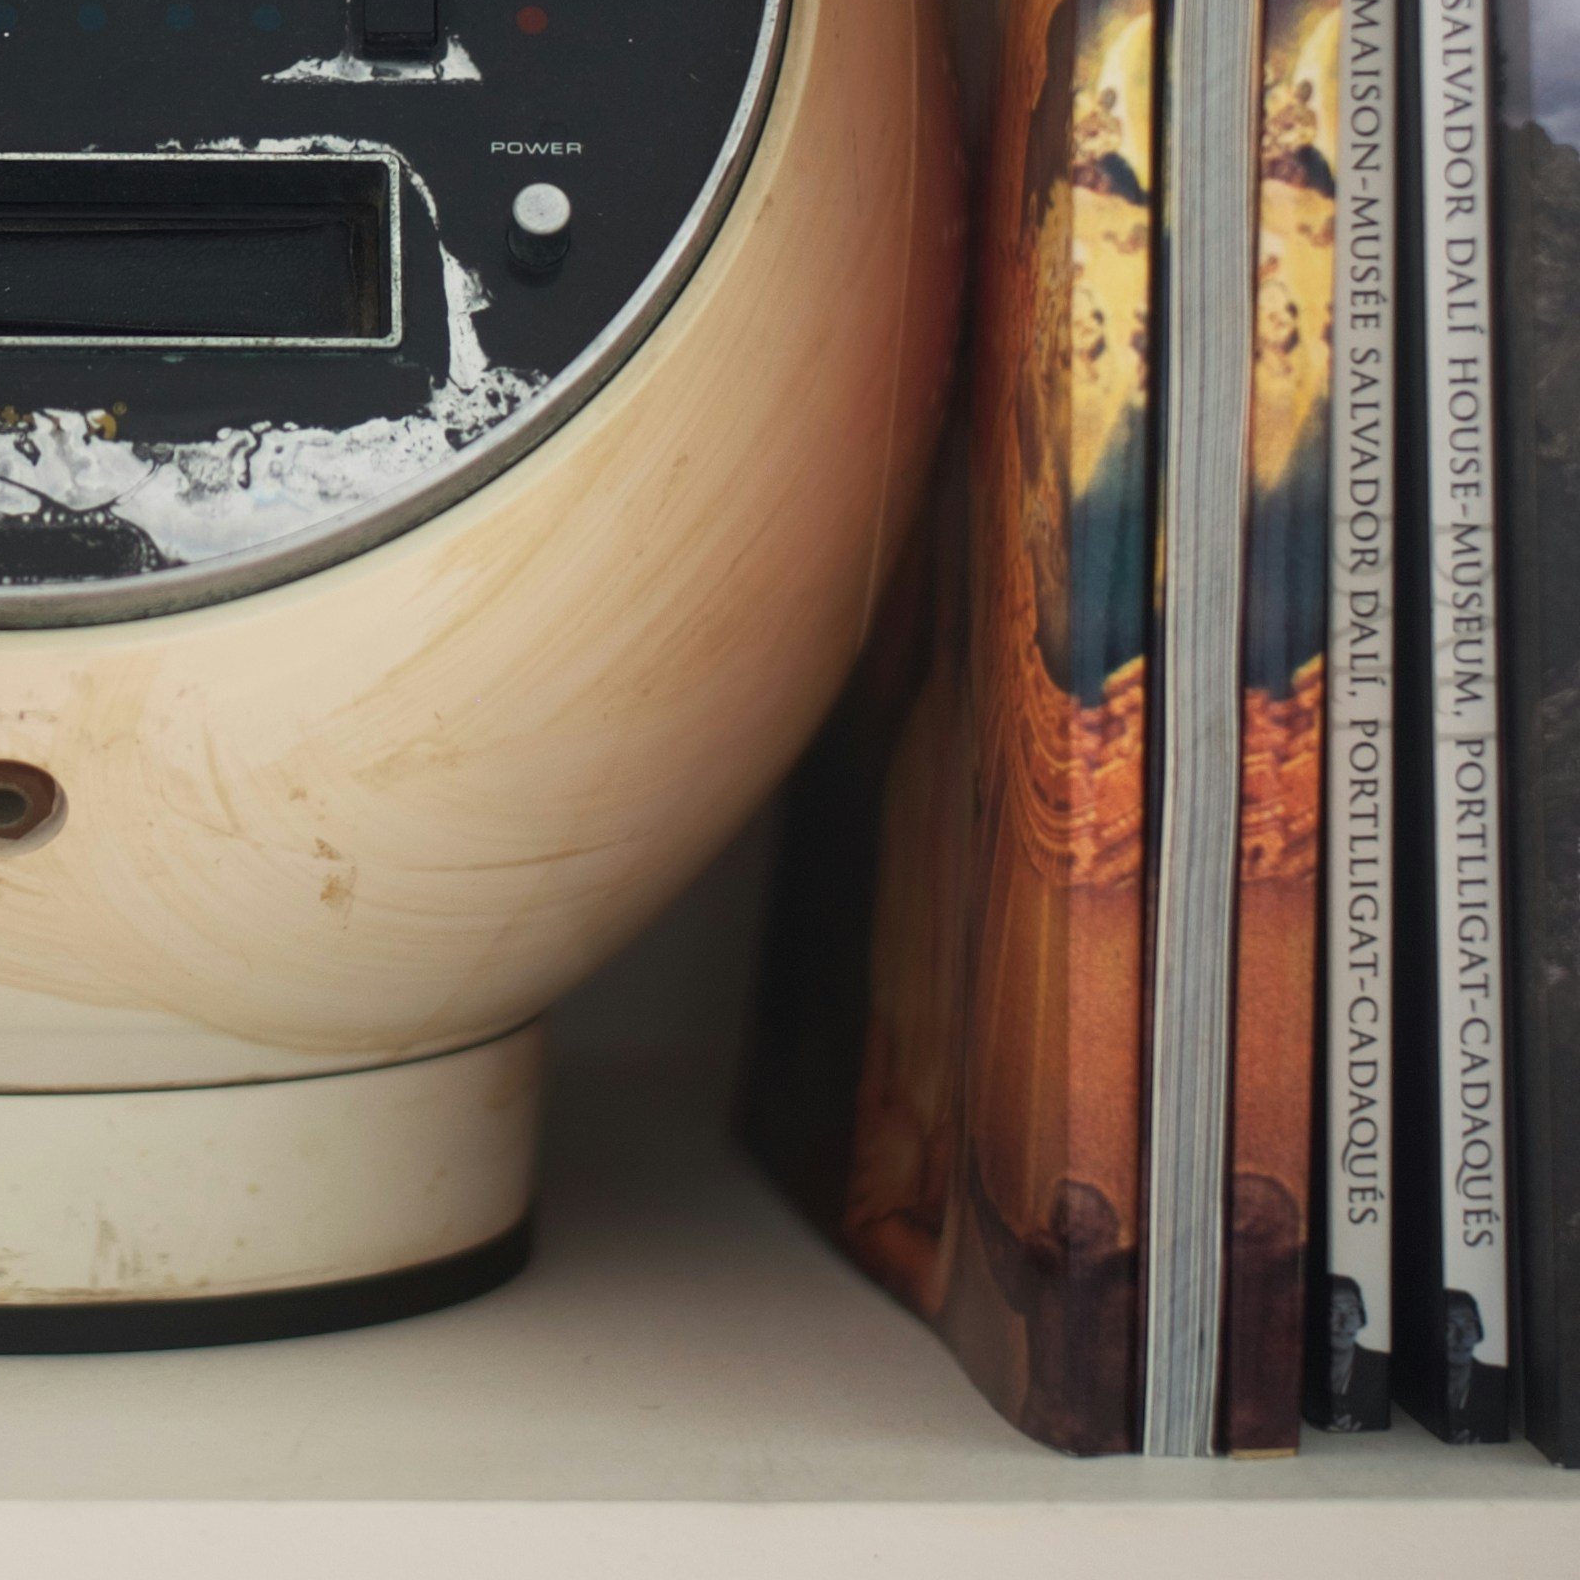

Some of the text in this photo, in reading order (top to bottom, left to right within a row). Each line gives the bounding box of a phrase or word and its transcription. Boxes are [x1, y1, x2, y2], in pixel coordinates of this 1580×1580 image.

[490, 141, 583, 155] POWER
[1444, 234, 1486, 335] DALÍ
[1349, 346, 1382, 575] SALVADOR
[1446, 356, 1486, 718] HOUSE-MUSEUM,
[1348, 590, 1387, 699] DALÍ,
[1340, 719, 1386, 1226] PORTLLIGAT-CADAQUÉS
[1454, 738, 1501, 1247] PORTLLIGAT-CADAQUÉS
